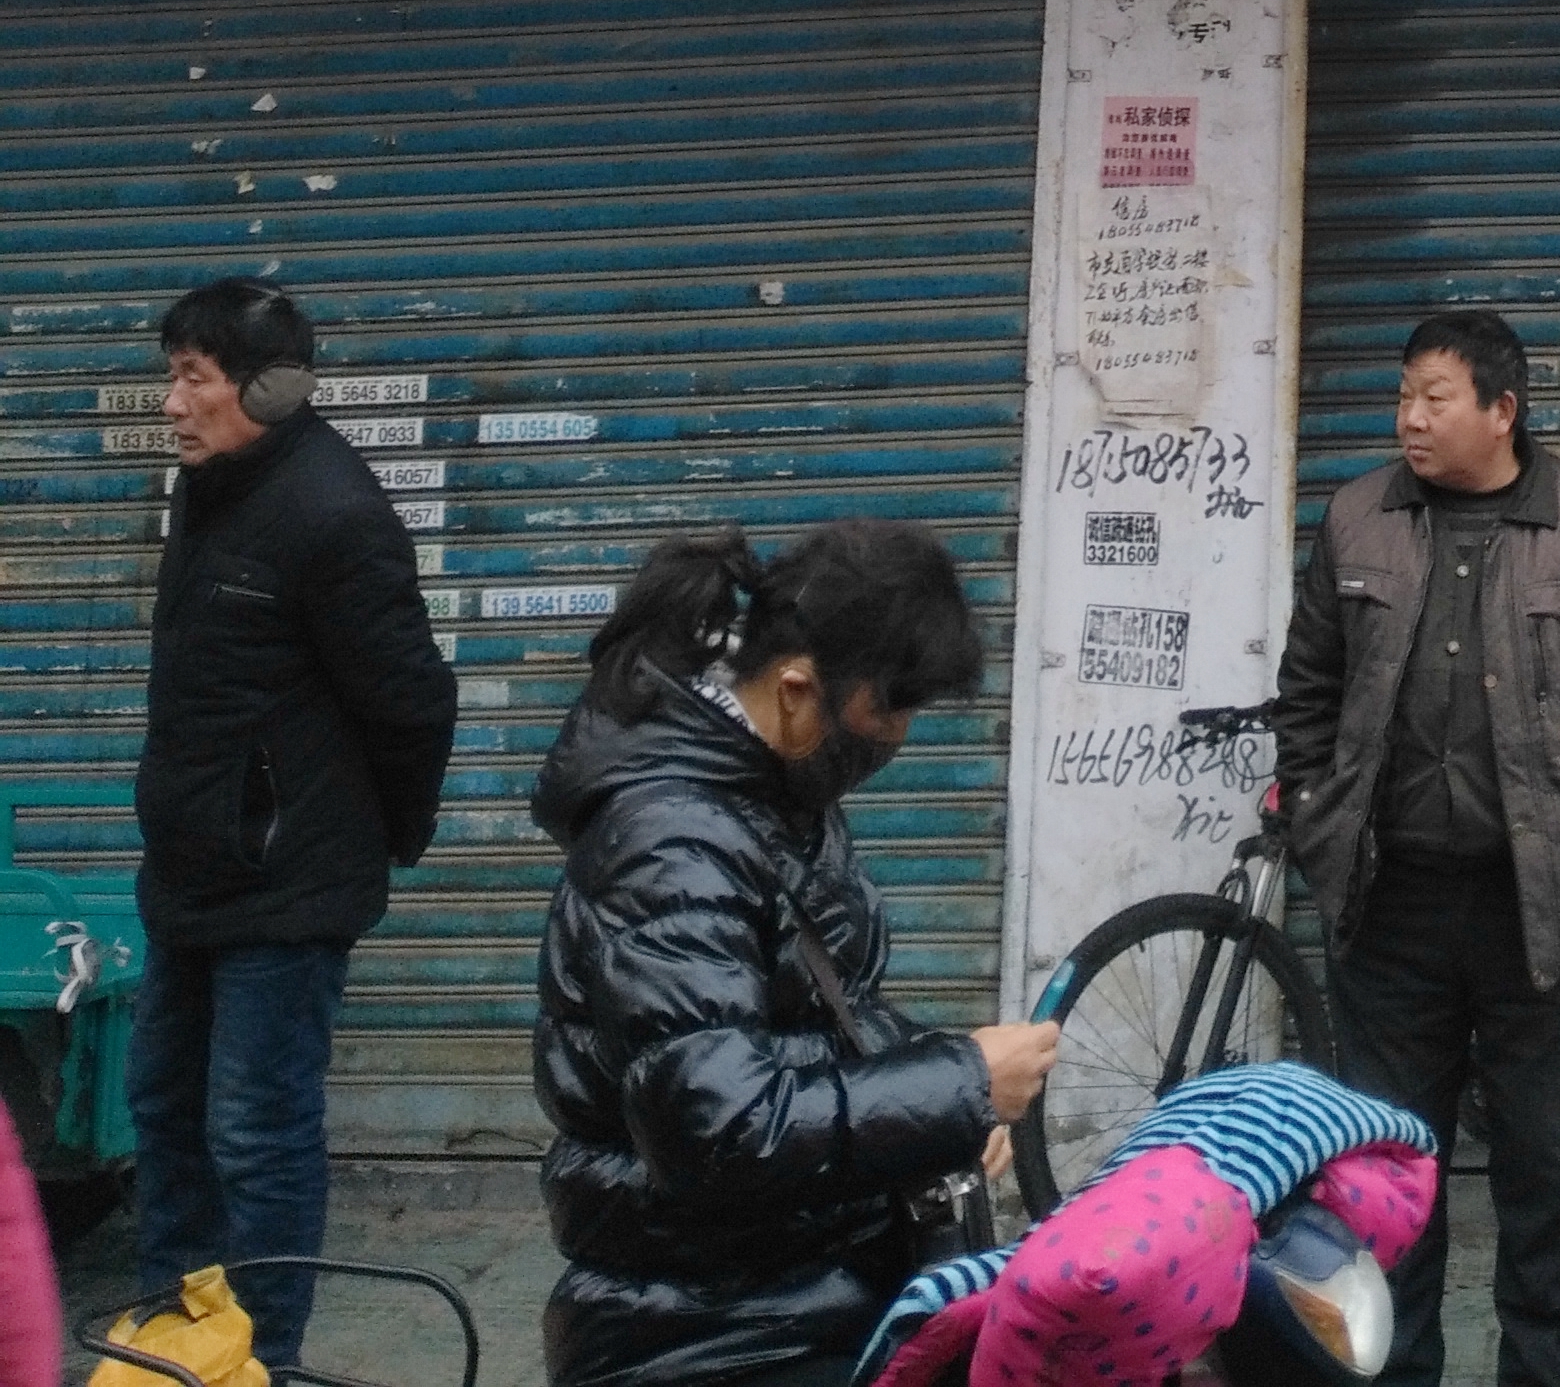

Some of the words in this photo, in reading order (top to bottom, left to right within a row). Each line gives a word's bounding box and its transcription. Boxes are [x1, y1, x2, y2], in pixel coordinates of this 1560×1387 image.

[1124, 107, 1191, 127] 私家侦探
[342, 385, 378, 401] 5645
[384, 384, 420, 400] 3218
[378, 426, 415, 443] 0933
[488, 421, 514, 440] 135
[395, 468, 432, 484] 6057
[1087, 545, 1157, 563] 3321600
[492, 597, 520, 616] 139
[526, 595, 562, 615] 5641
[569, 593, 608, 613] 5500
[1084, 648, 1180, 686] 55409182
